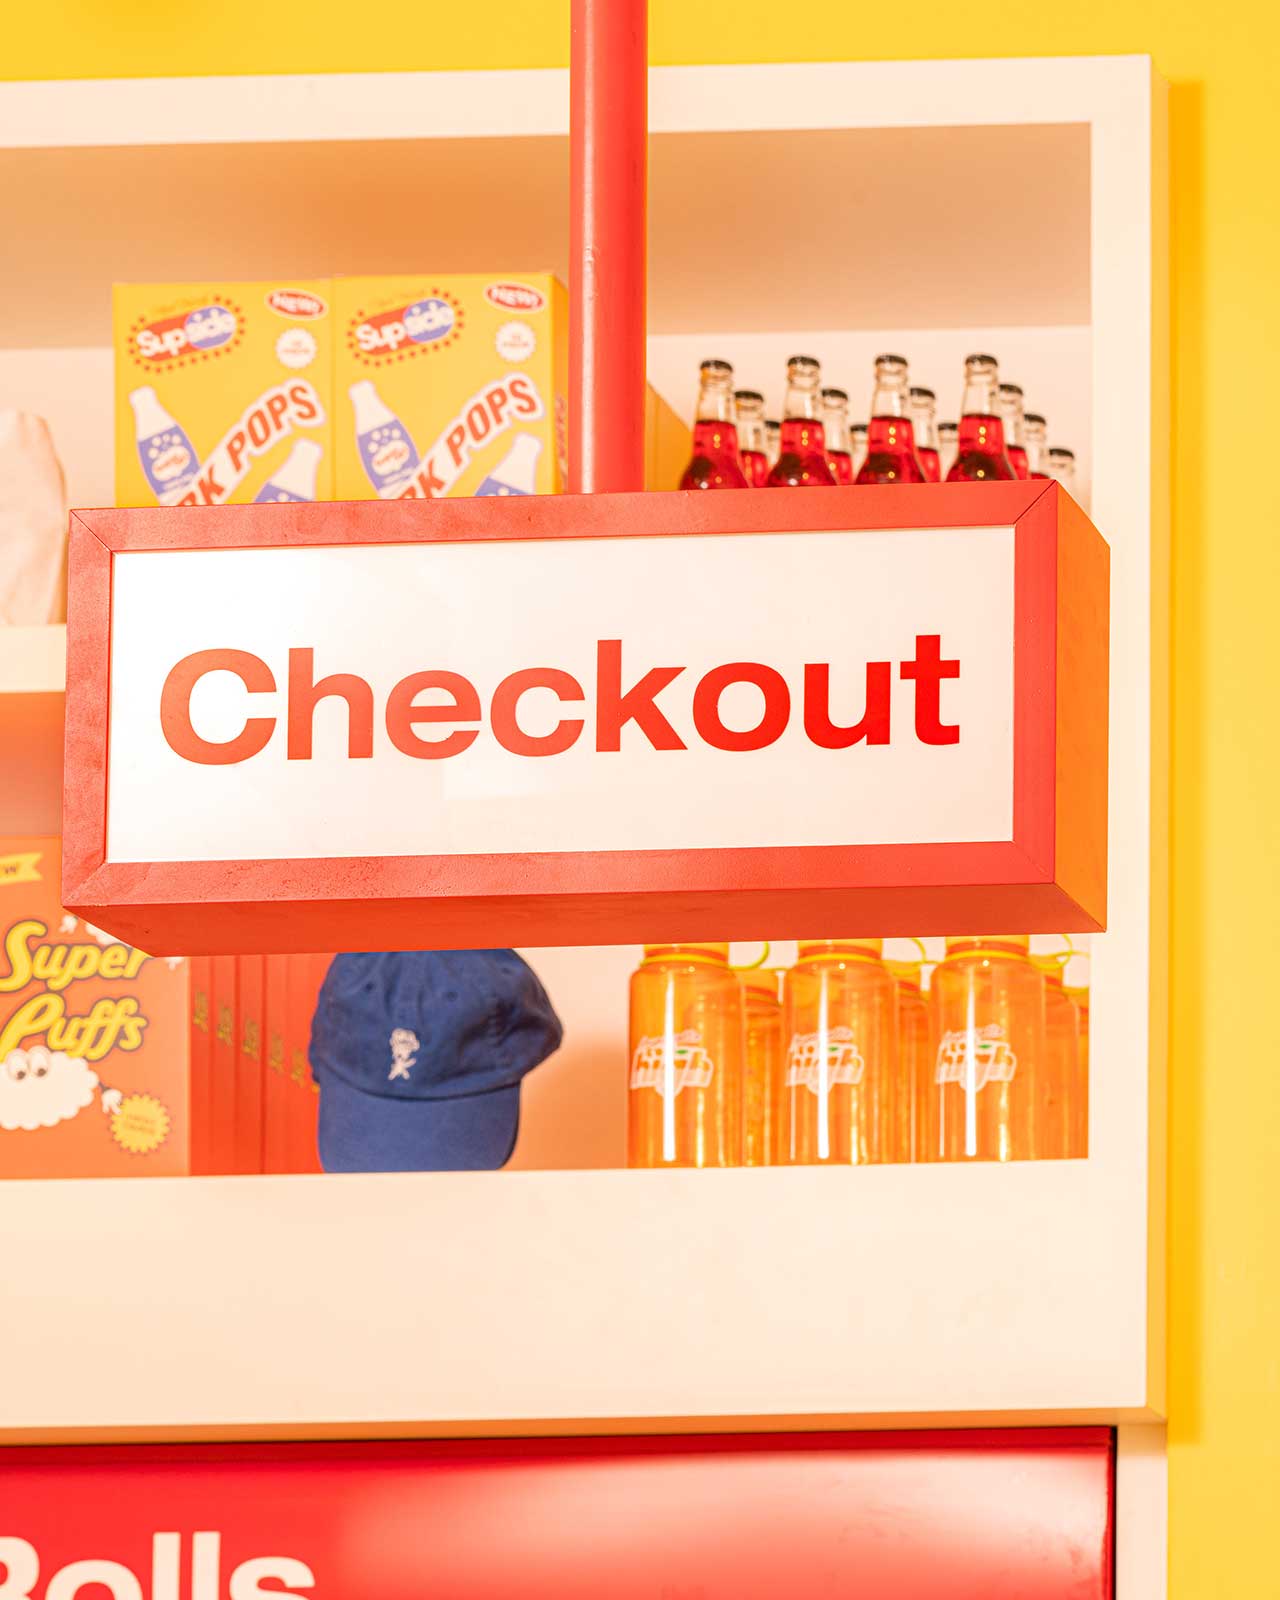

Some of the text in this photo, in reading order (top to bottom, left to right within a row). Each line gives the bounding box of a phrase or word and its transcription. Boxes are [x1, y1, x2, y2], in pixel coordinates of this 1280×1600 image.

[227, 386, 316, 472] POPS
[446, 380, 537, 468] POPS
[161, 635, 960, 765] Checkout
[0, 920, 147, 992] Super
[0, 994, 148, 1061] Puffs
